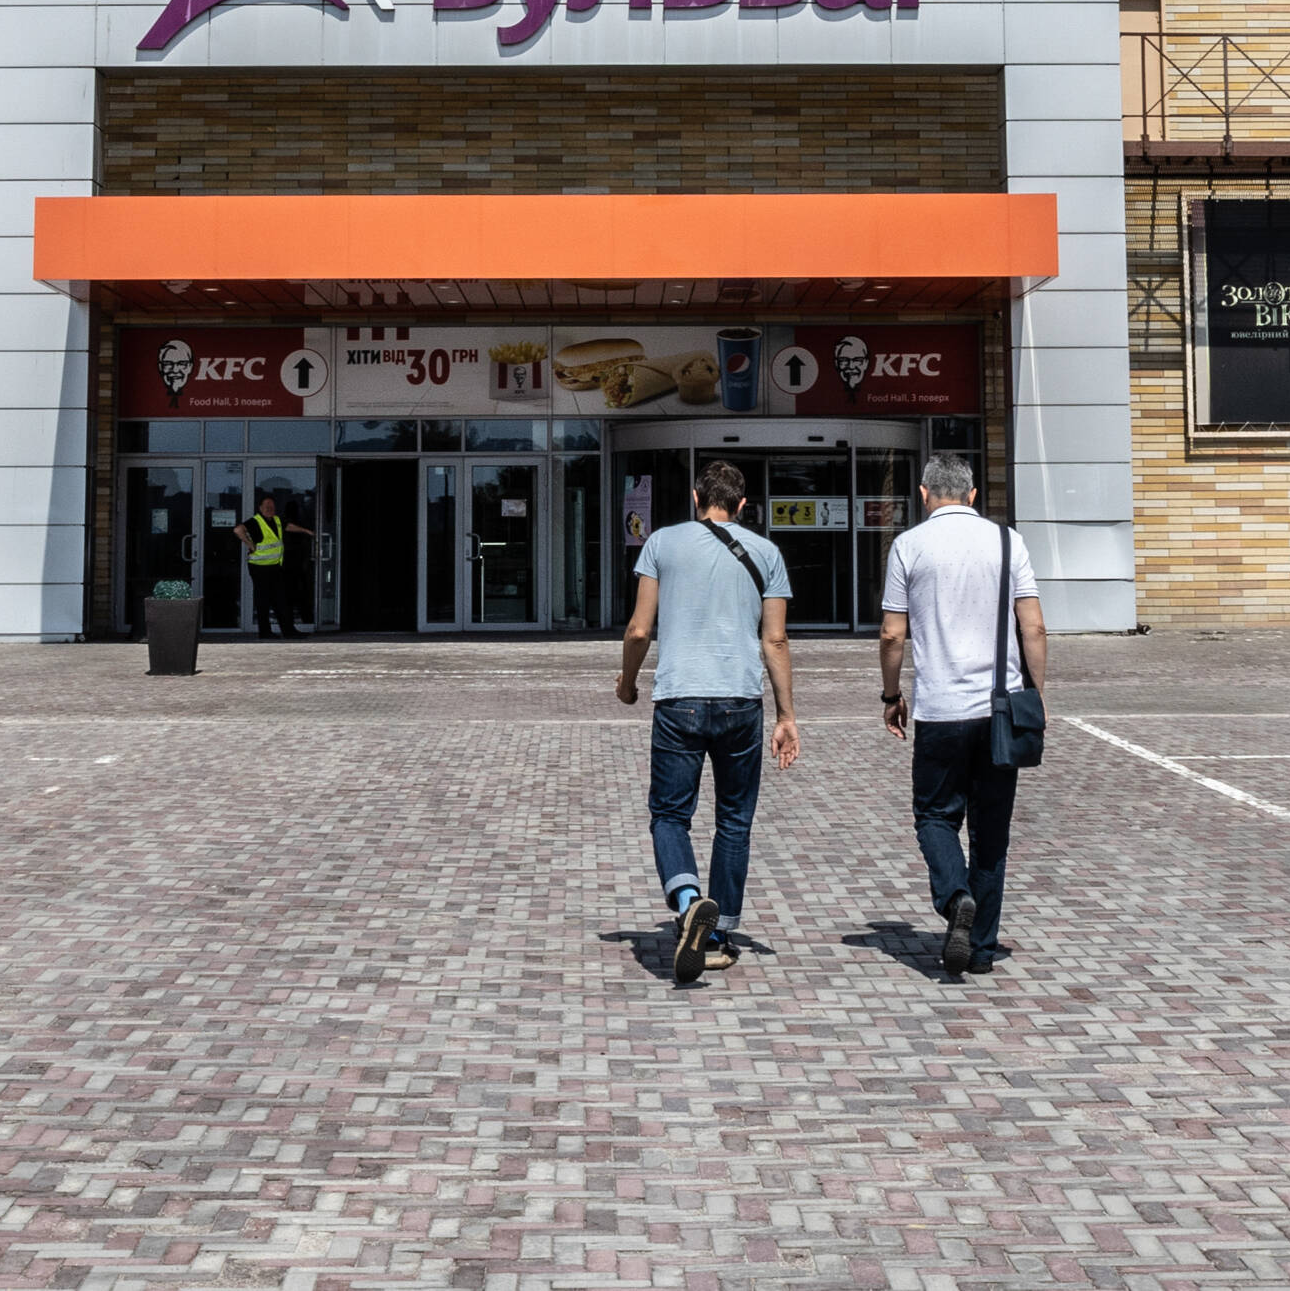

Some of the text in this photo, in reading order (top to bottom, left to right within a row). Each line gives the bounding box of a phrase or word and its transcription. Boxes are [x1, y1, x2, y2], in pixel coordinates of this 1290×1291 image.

[1231, 330, 1289, 340] ювелірний
[194, 357, 266, 381] KFC
[346, 348, 478, 385] ХІТИ ВІД 30 ГРН
[871, 353, 942, 377] KFC
[189, 397, 211, 406] Food
[241, 399, 271, 408] поверх
[867, 394, 889, 402] Food
[911, 394, 917, 402] 3
[918, 395, 950, 404] поверх
